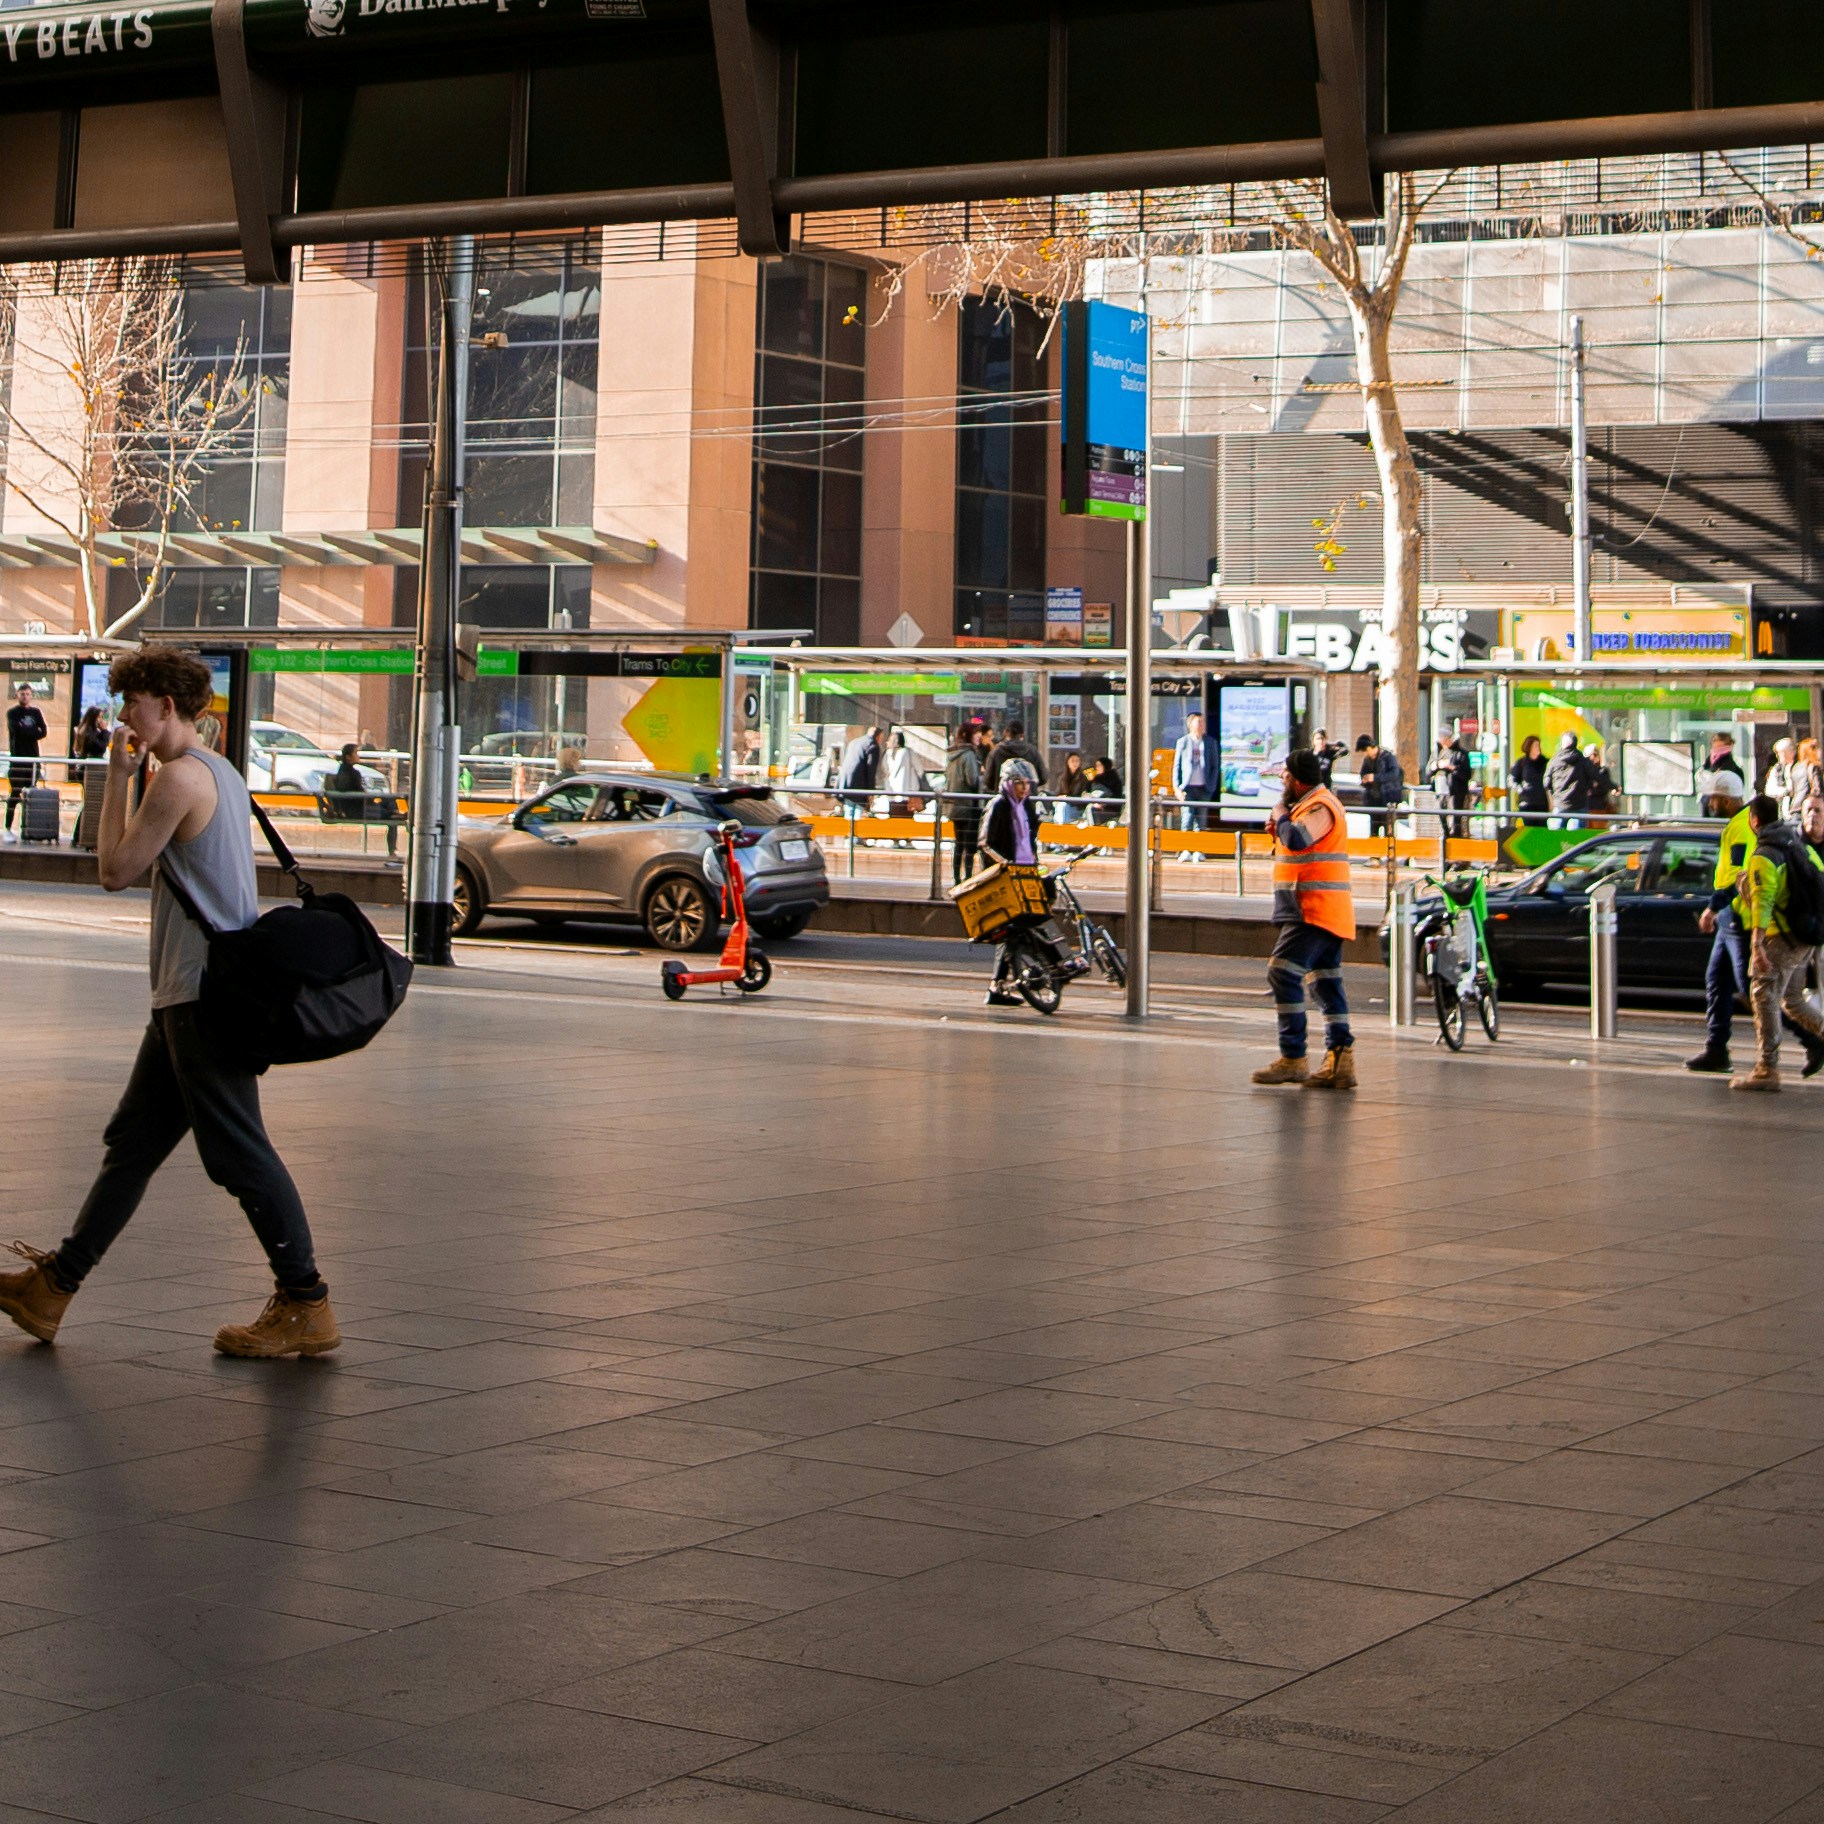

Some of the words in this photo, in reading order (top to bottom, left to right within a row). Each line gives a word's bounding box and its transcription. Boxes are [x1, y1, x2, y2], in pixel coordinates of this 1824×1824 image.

[36, 8, 154, 59] BEATS
[23, 621, 46, 635] 120
[1632, 630, 1731, 650] TOBACCONIST
[279, 655, 296, 668] 122
[349, 654, 378, 668] Cross
[623, 658, 653, 671] Trams
[656, 658, 669, 671] To
[671, 658, 693, 674] City
[1161, 681, 1180, 694] City
